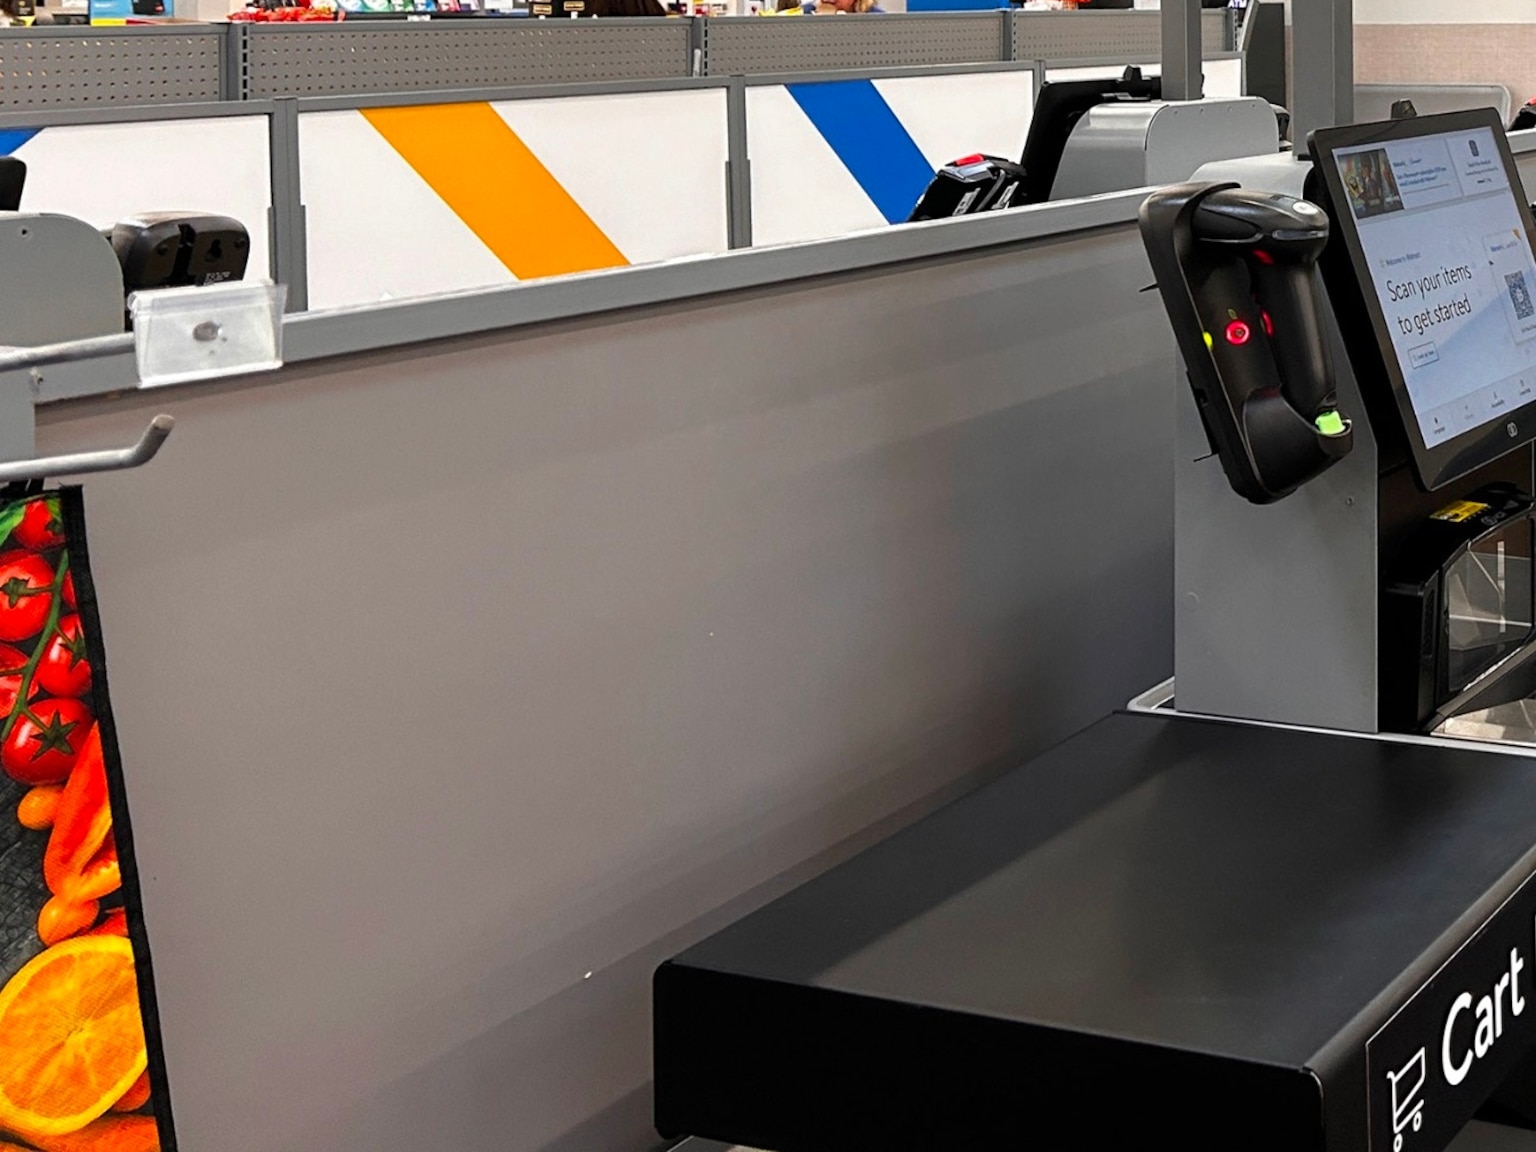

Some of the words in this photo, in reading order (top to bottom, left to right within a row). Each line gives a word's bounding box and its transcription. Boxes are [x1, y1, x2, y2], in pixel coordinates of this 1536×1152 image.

[1386, 280, 1417, 302] Scan
[1417, 272, 1441, 300] your
[1440, 264, 1472, 287] items
[1397, 315, 1413, 336] to
[1413, 308, 1435, 336] get
[1434, 293, 1472, 324] started
[1442, 947, 1526, 1086] Cart
